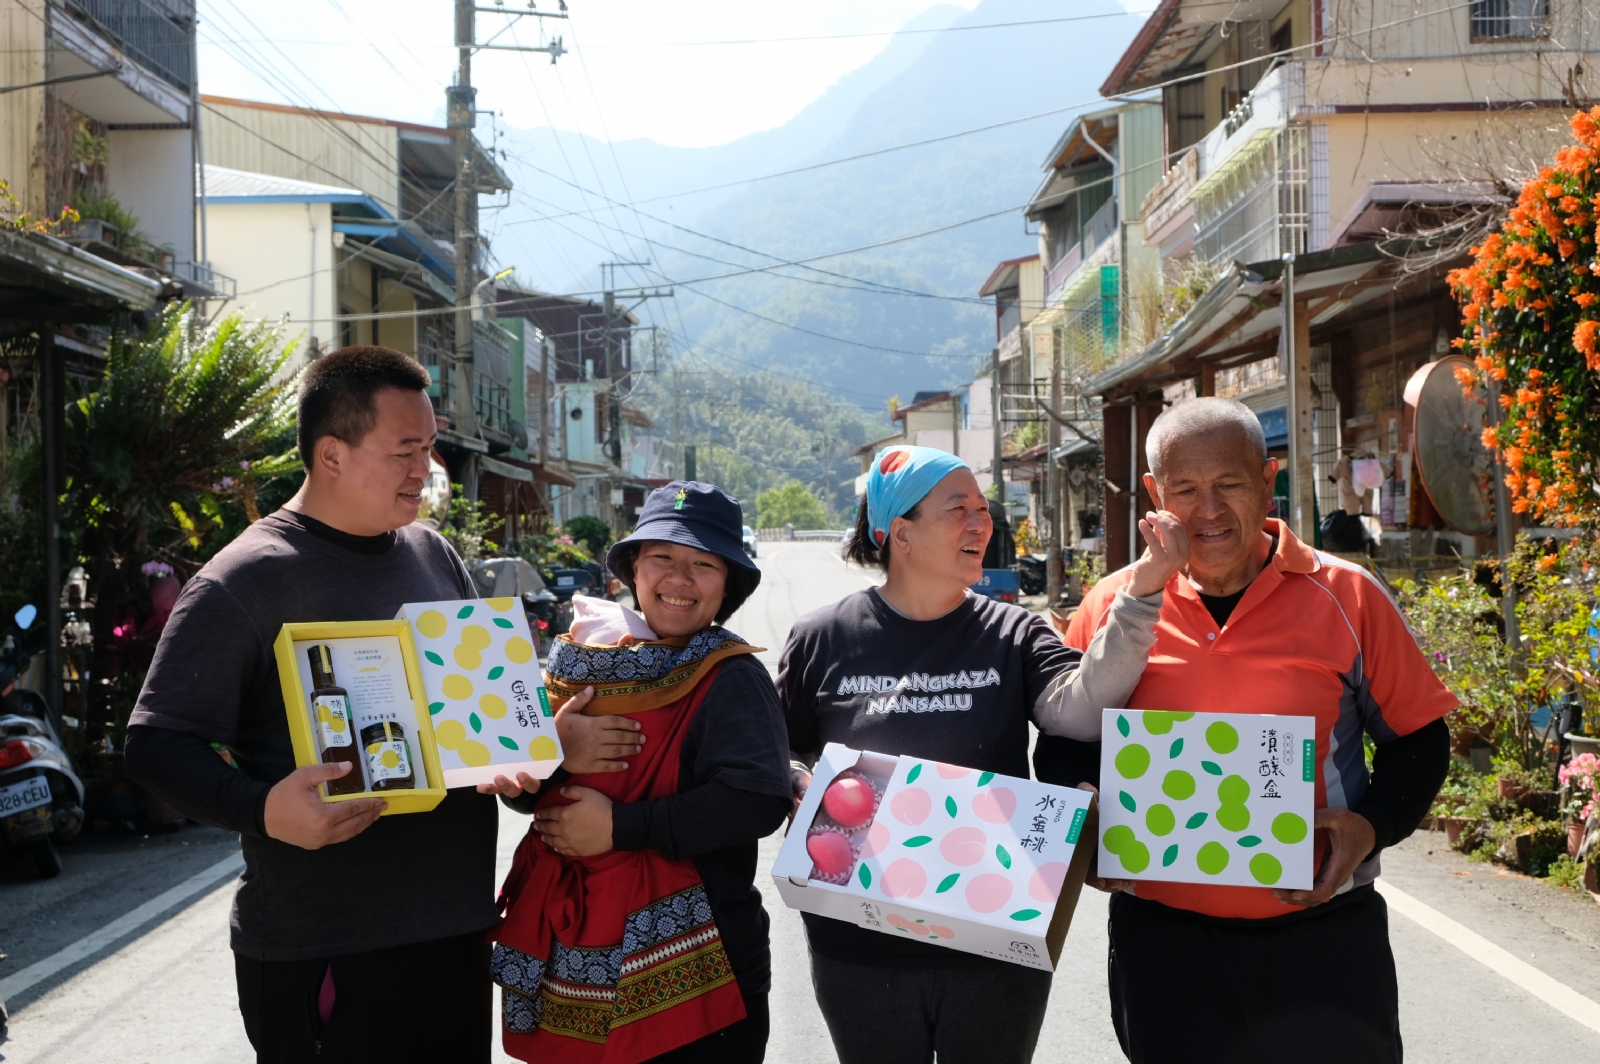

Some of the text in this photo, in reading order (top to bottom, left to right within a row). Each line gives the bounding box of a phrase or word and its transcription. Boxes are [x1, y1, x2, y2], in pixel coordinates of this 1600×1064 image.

[837, 667, 1001, 696] MINDANGKAZA
[866, 694, 973, 715] NANSALU
[1020, 794, 1057, 854] 水蜜桃
[1053, 799, 1067, 824] UTUNG
[860, 901, 883, 929] 水蜜桃
